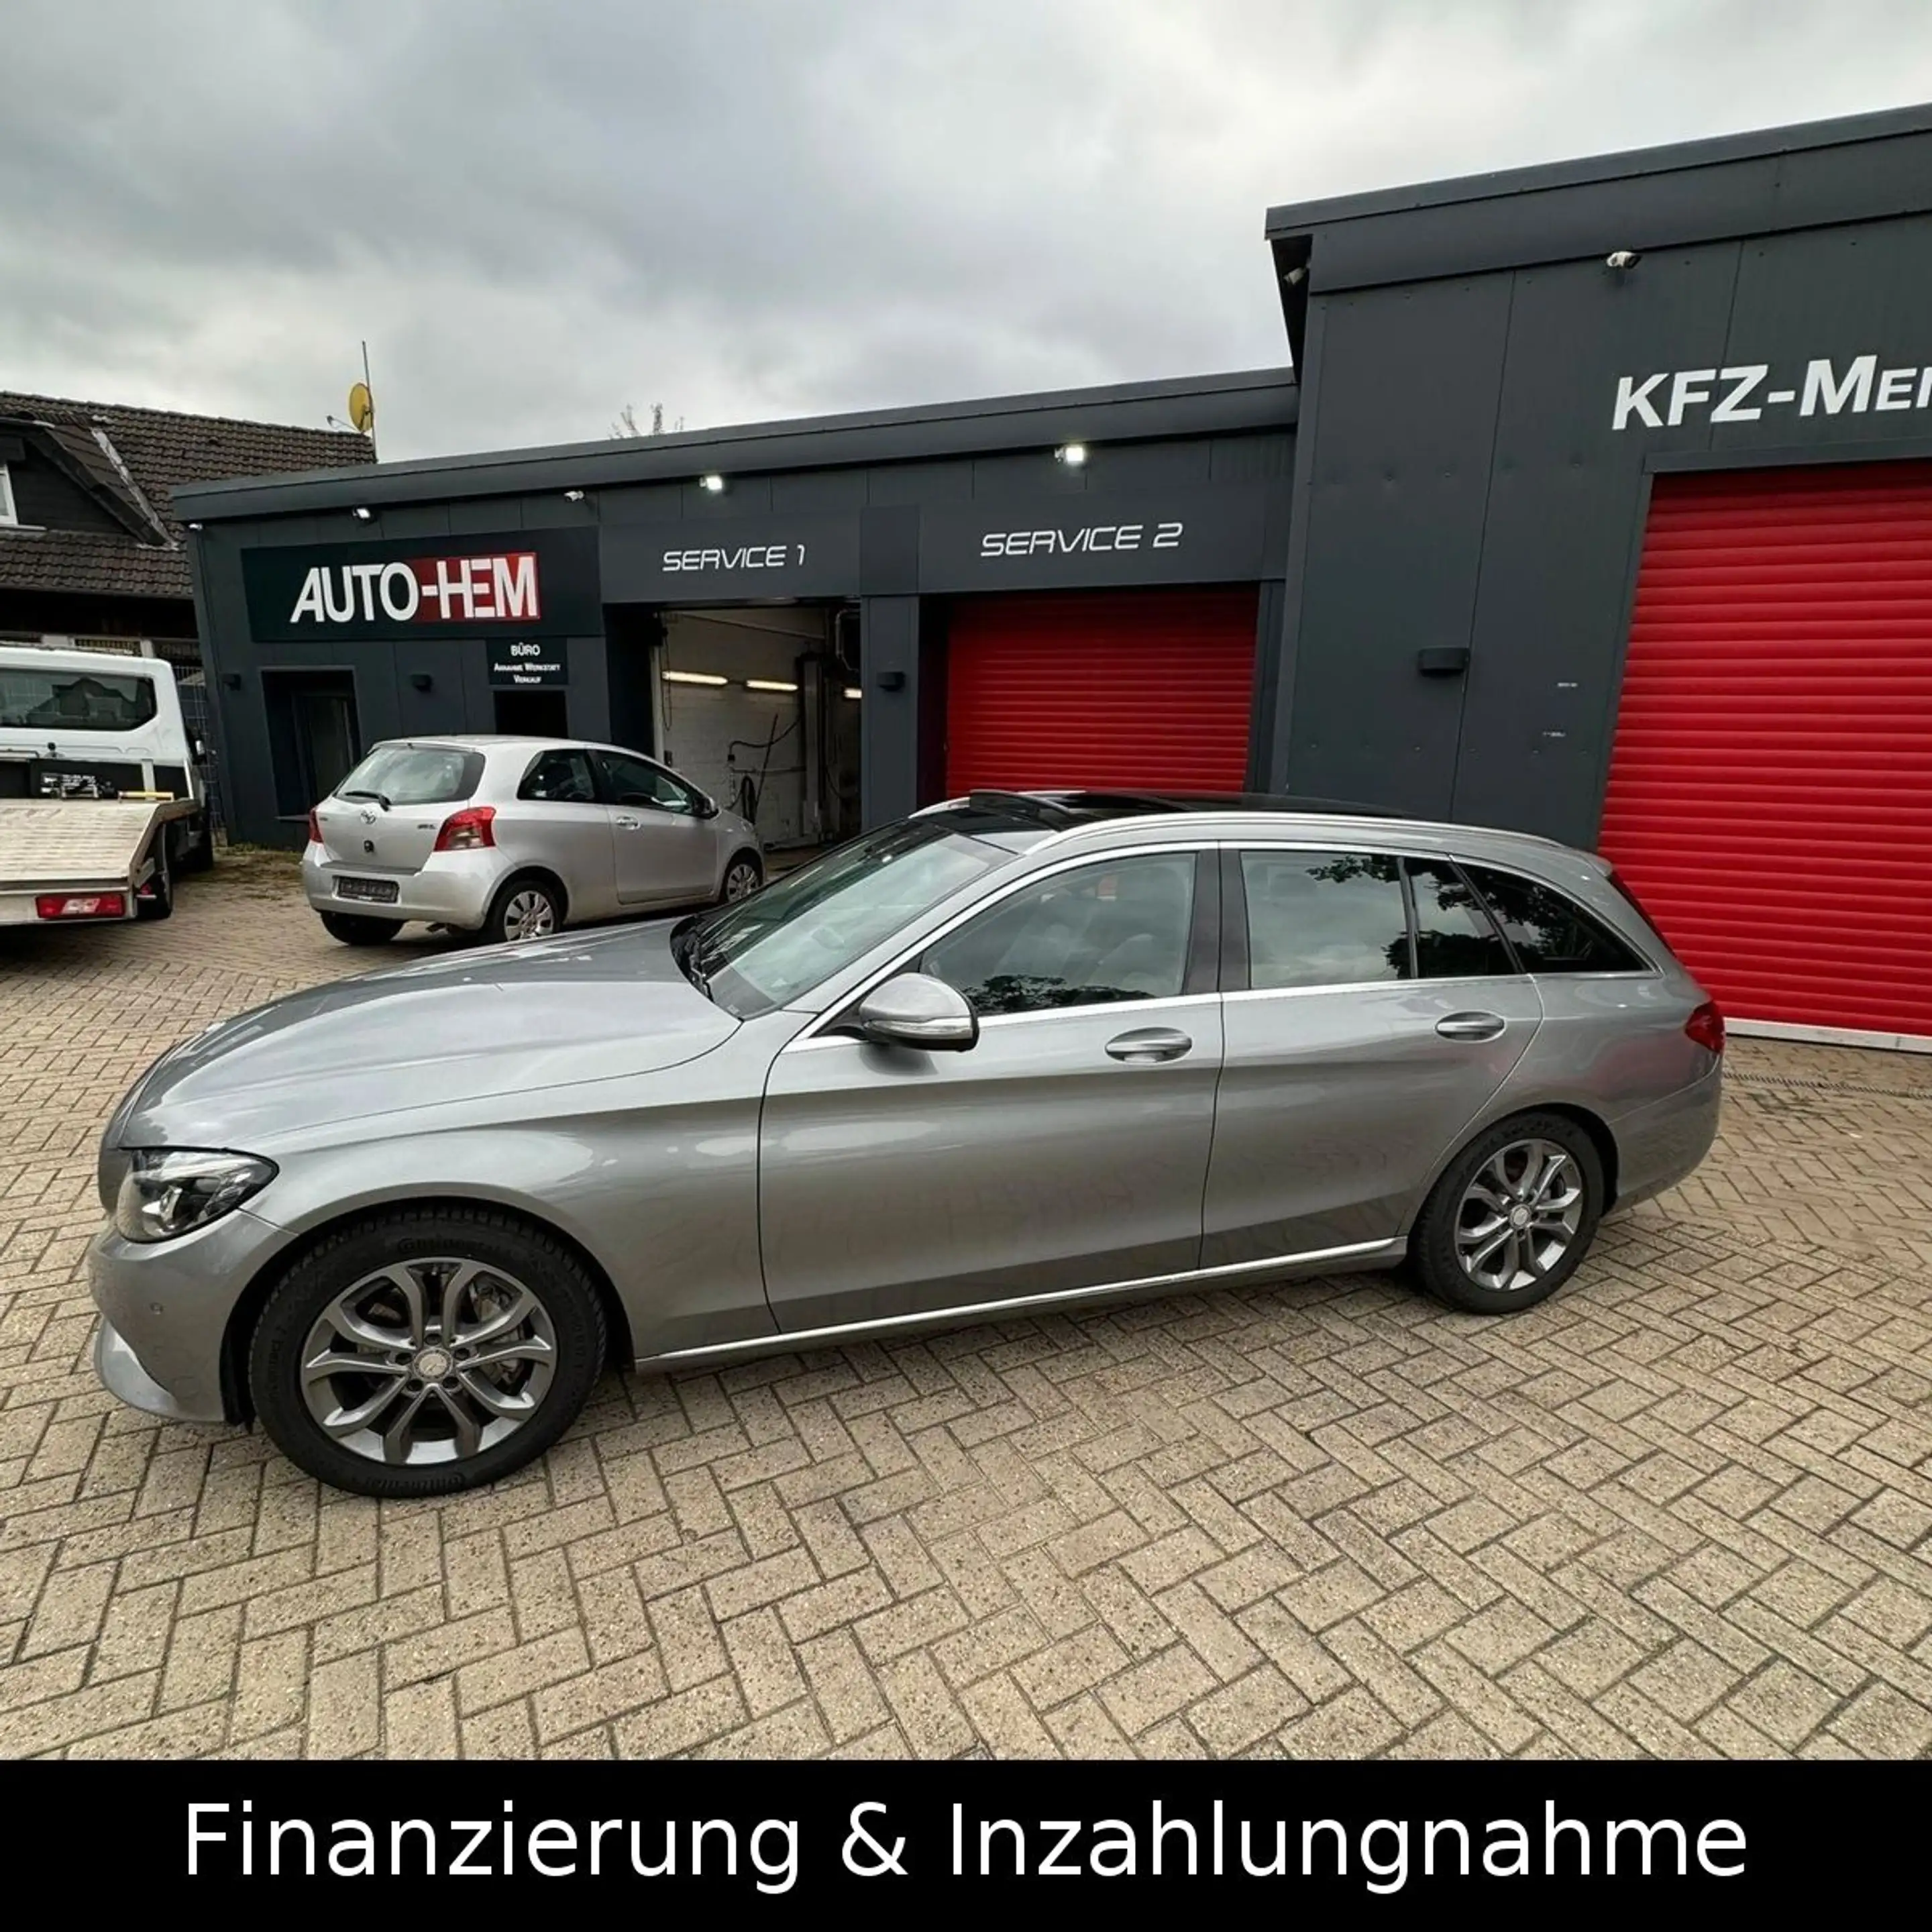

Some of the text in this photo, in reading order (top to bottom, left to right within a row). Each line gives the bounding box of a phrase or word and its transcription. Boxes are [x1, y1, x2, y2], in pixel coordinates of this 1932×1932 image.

[980, 521, 1183, 557] SERVICE 2
[661, 544, 805, 572] SERVICE 1
[290, 555, 537, 623] AUTO-HEM
[511, 642, 541, 656] BÜRO
